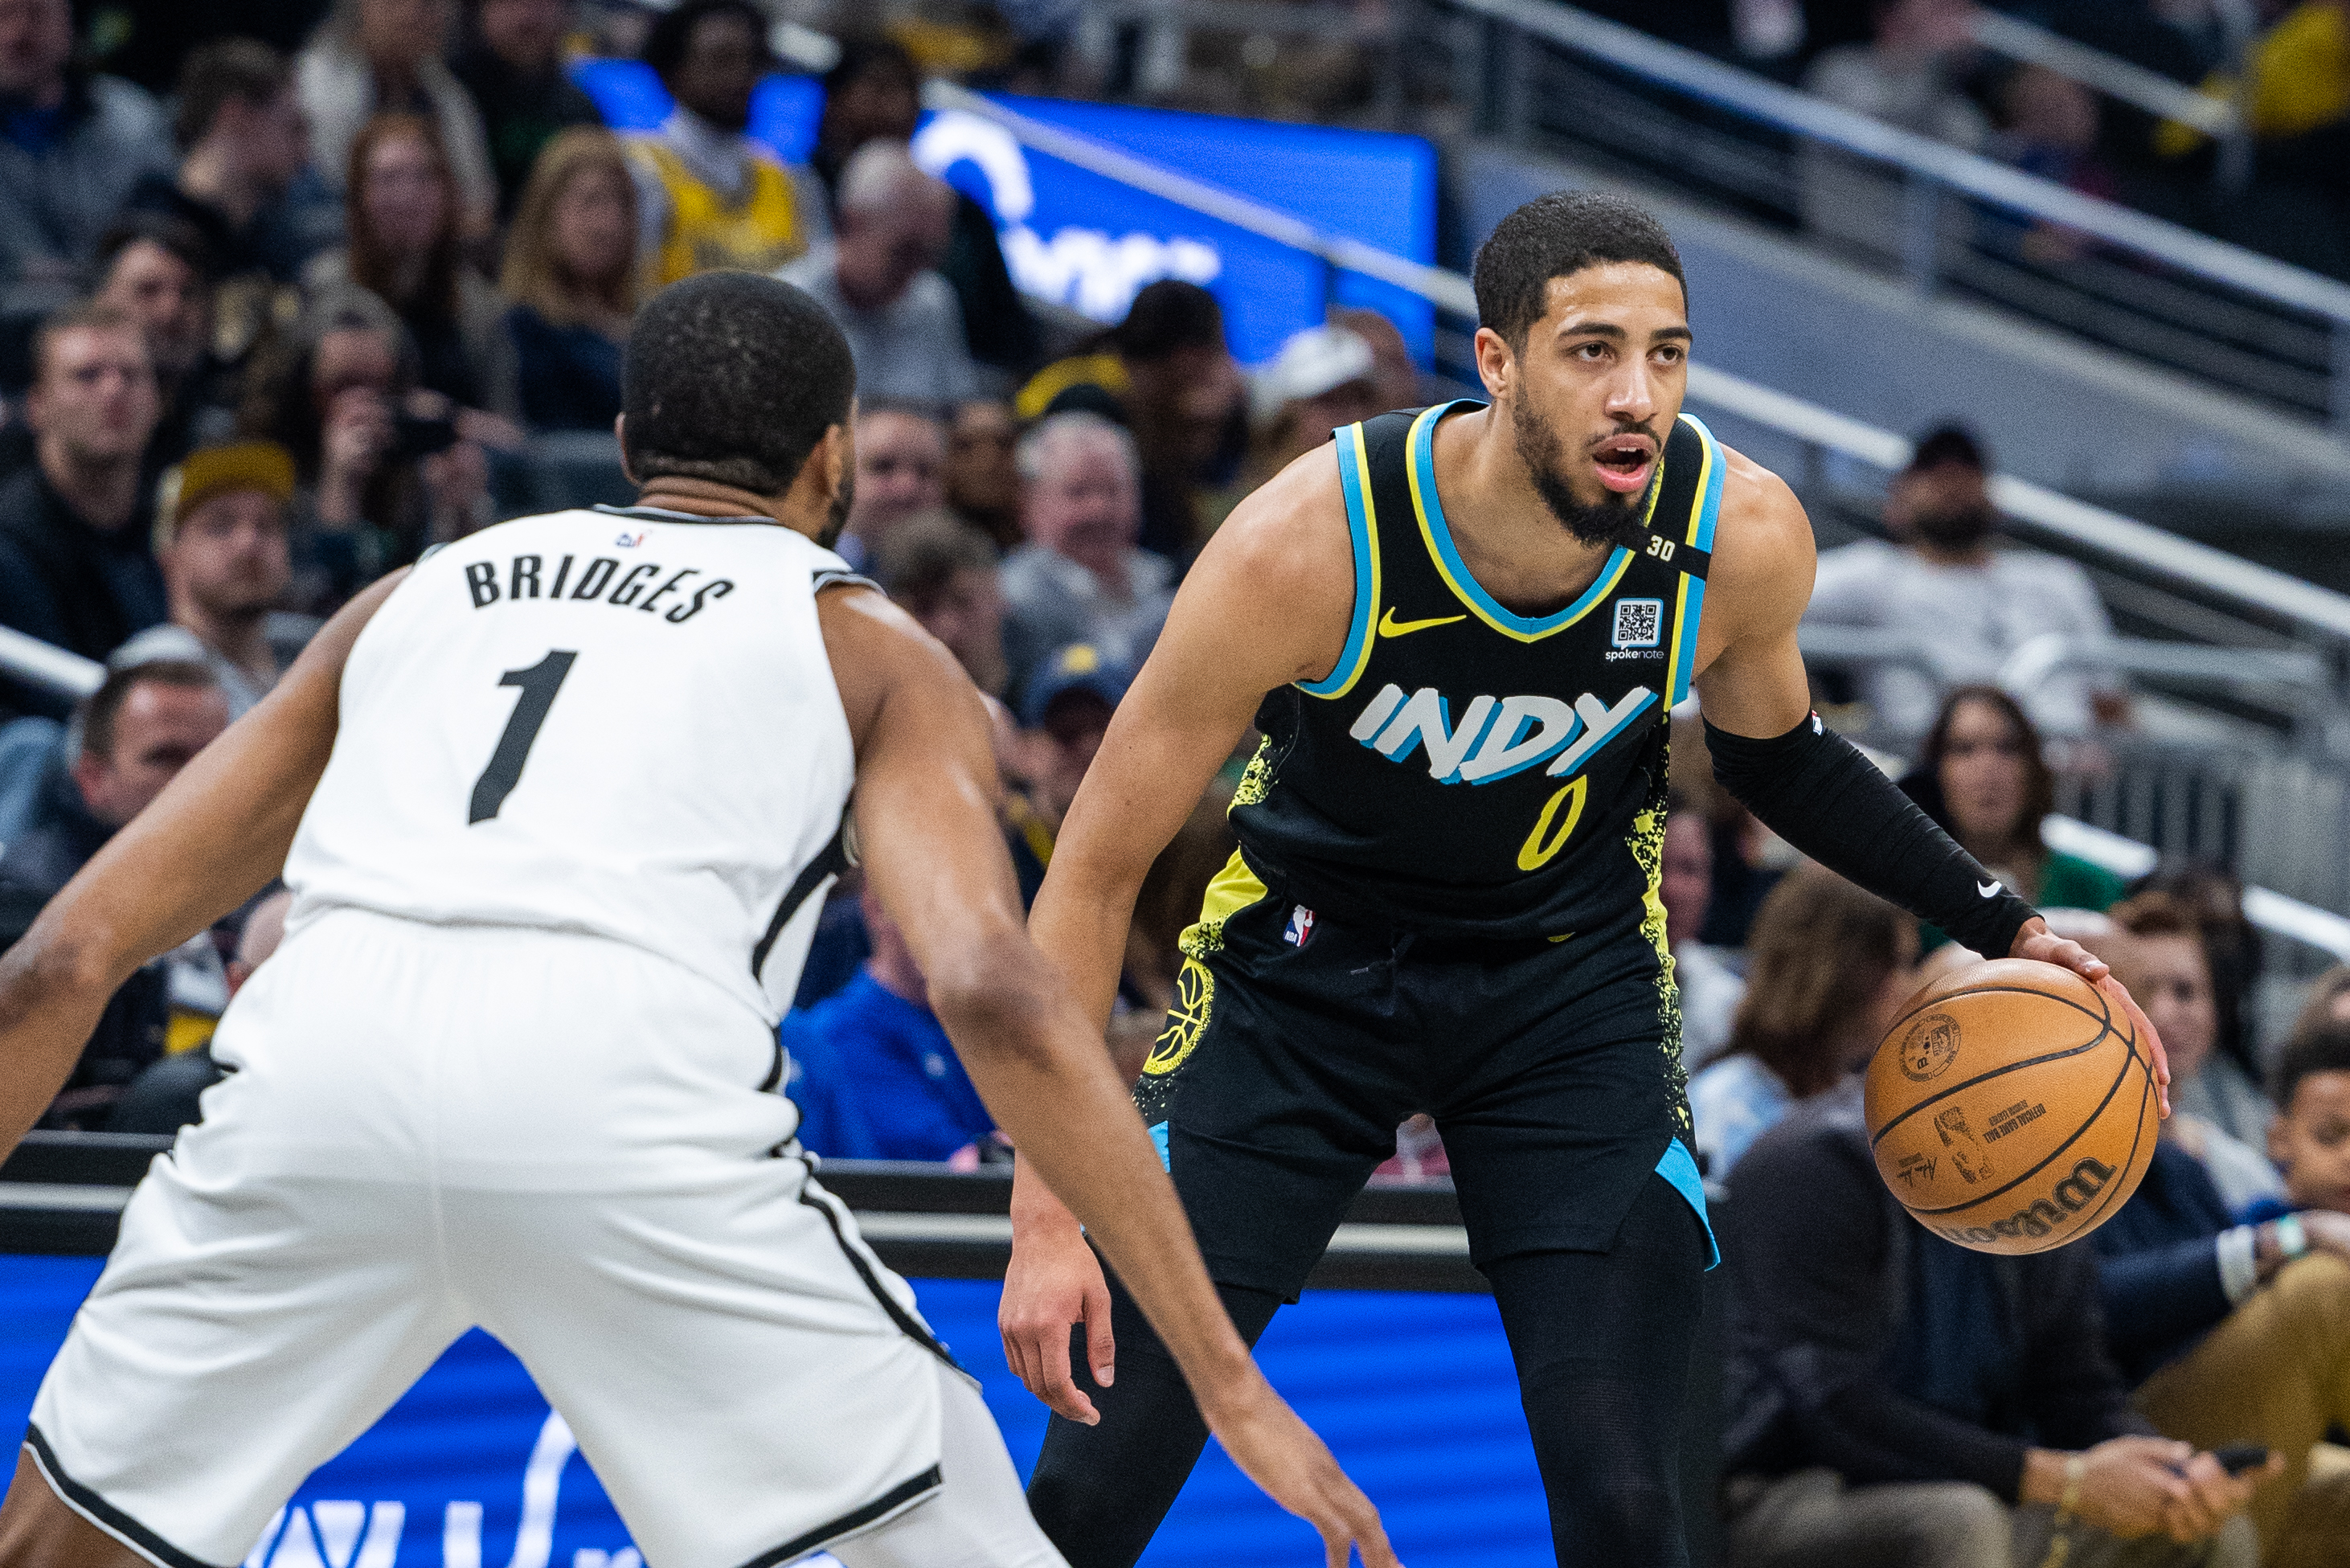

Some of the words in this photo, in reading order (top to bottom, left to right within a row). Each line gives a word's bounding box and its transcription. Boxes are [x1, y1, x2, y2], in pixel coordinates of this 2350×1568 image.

[1647, 534, 1676, 562] 30
[465, 554, 735, 624] BRIDGES
[1605, 649, 1664, 662] spokenote
[469, 649, 579, 825] 1
[1349, 683, 1658, 785] INDY
[1517, 774, 1587, 871] 0
[1284, 931, 1298, 944] NBA
[1998, 1118, 2020, 1137] GAME
[2016, 1103, 2047, 1127] OFFICIAL
[1982, 1128, 2002, 1144] BALL
[1932, 1157, 2118, 1244] Wilson
